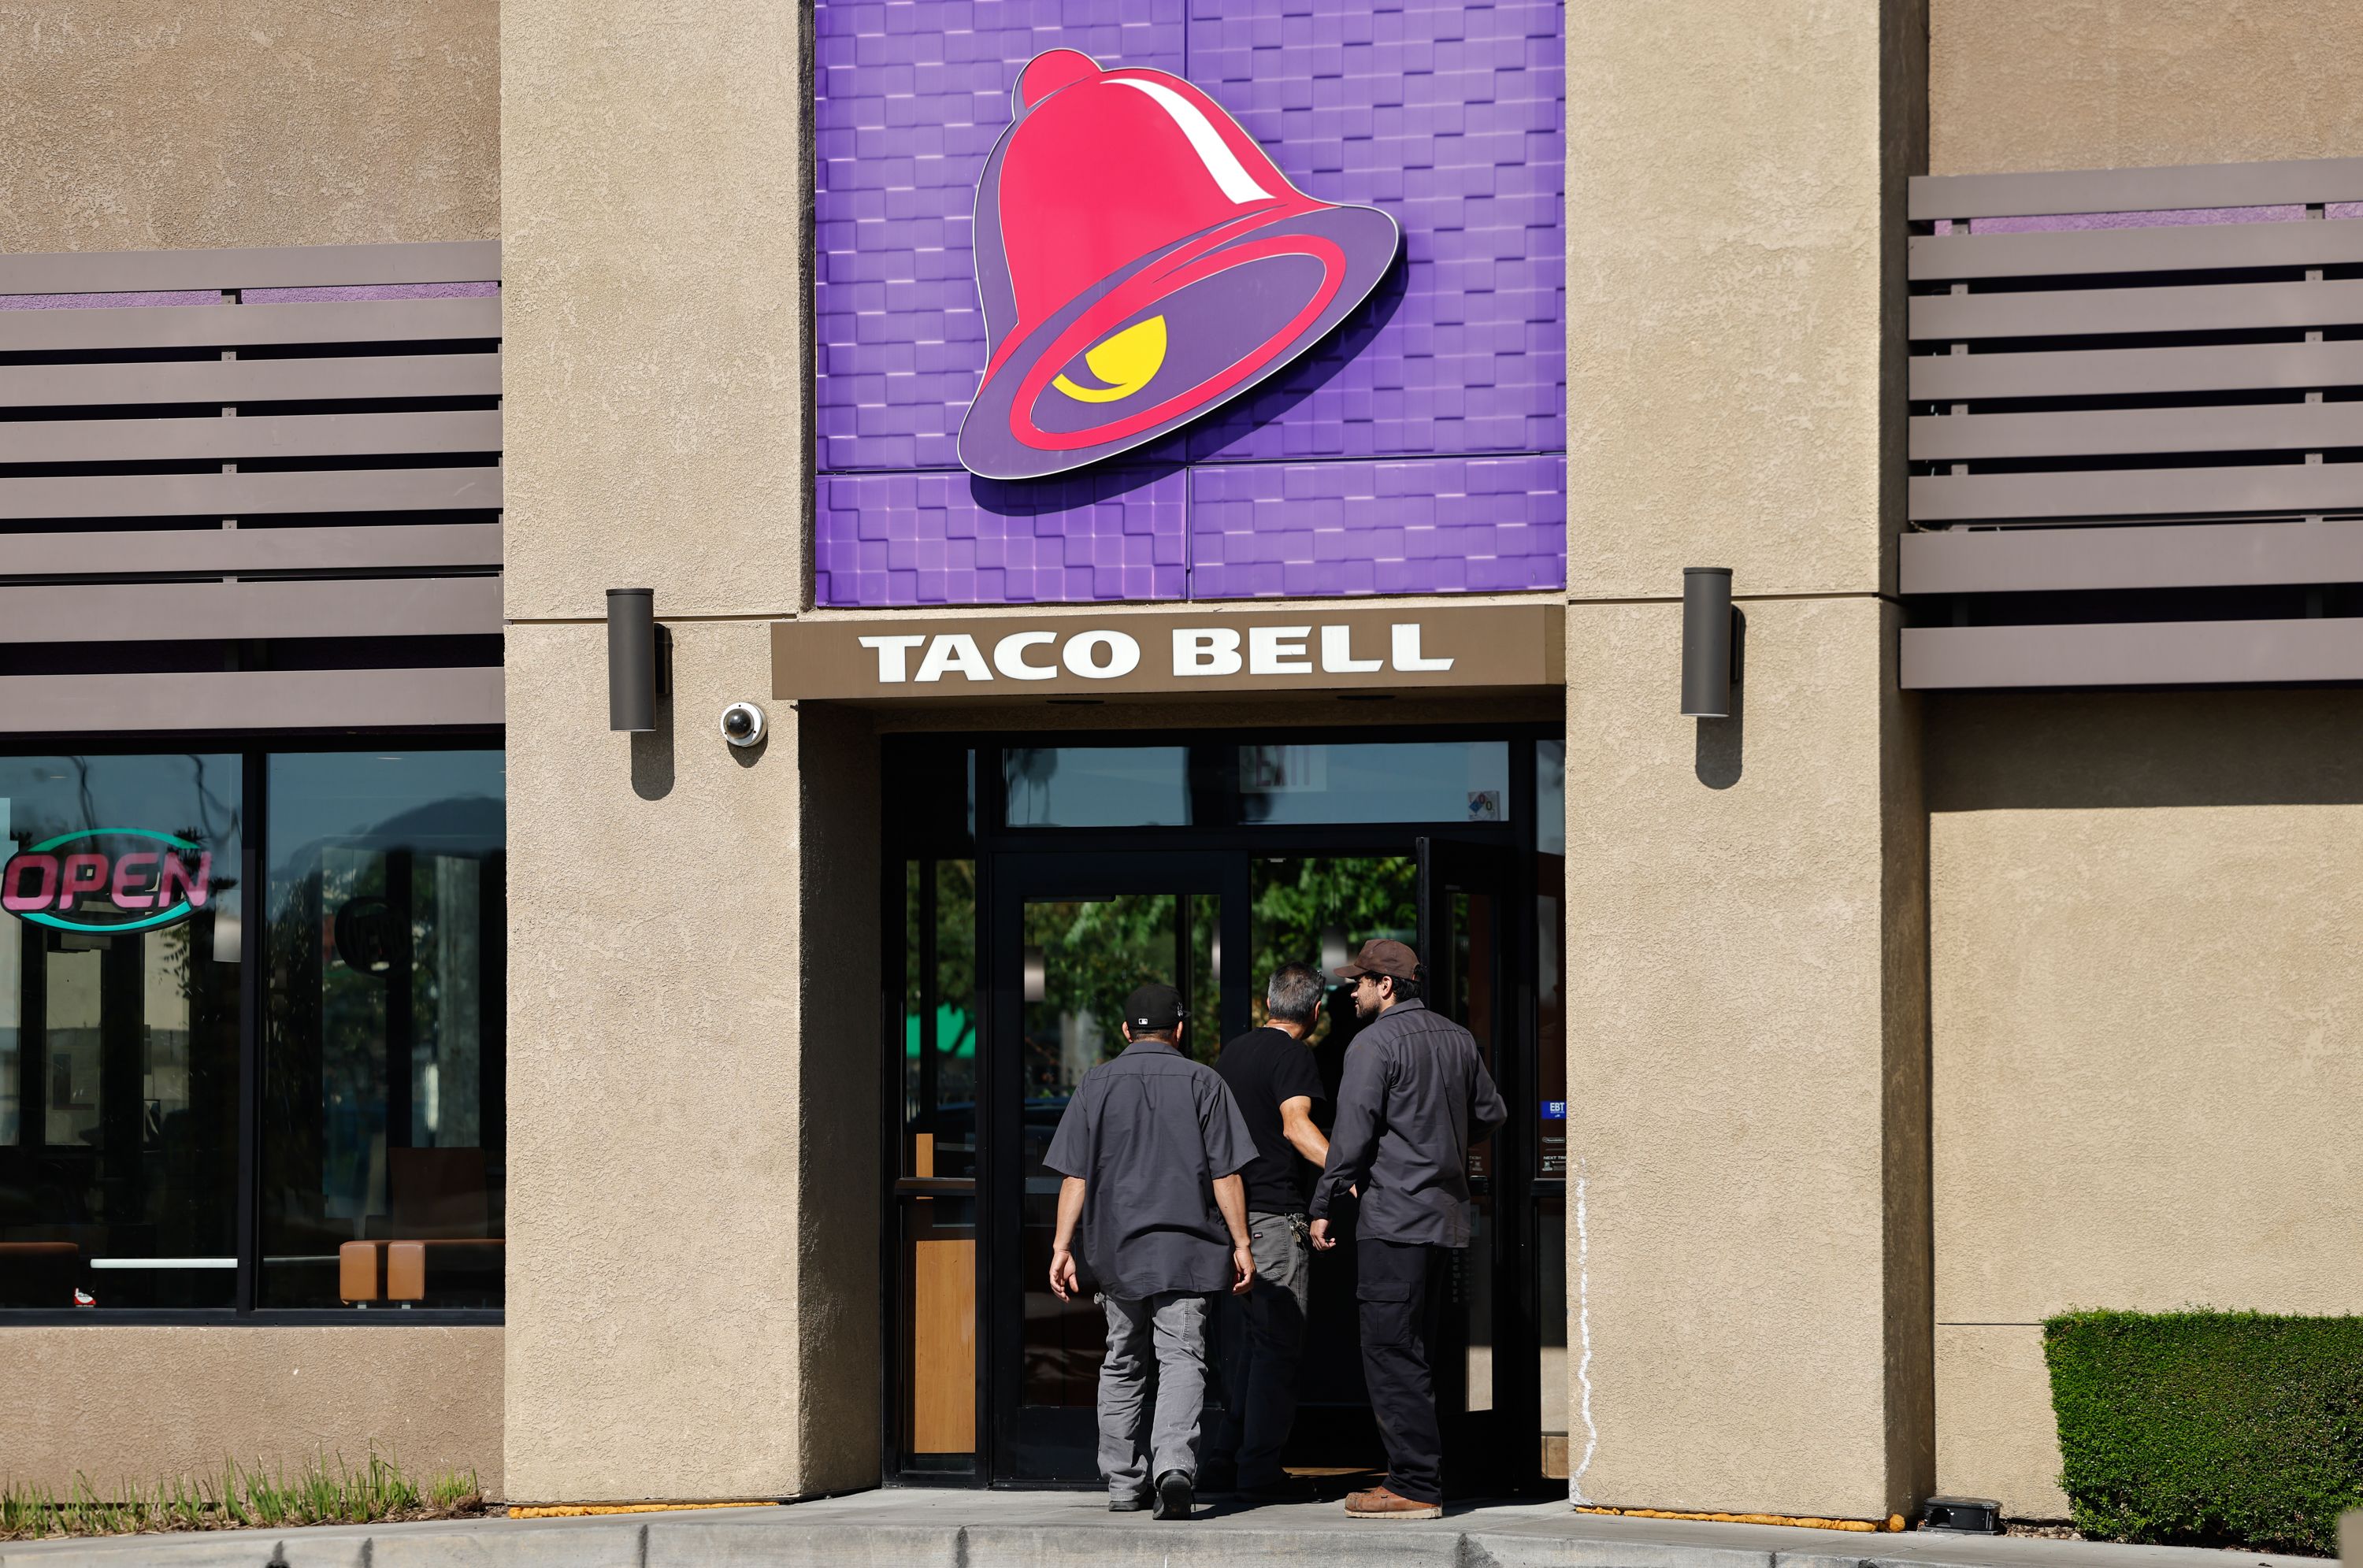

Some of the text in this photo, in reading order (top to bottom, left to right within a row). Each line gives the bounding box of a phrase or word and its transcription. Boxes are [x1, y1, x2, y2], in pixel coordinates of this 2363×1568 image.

[857, 624, 1455, 684] TACO BELL
[2, 851, 212, 910] OPEN
[1550, 1103, 1565, 1111] EBT
